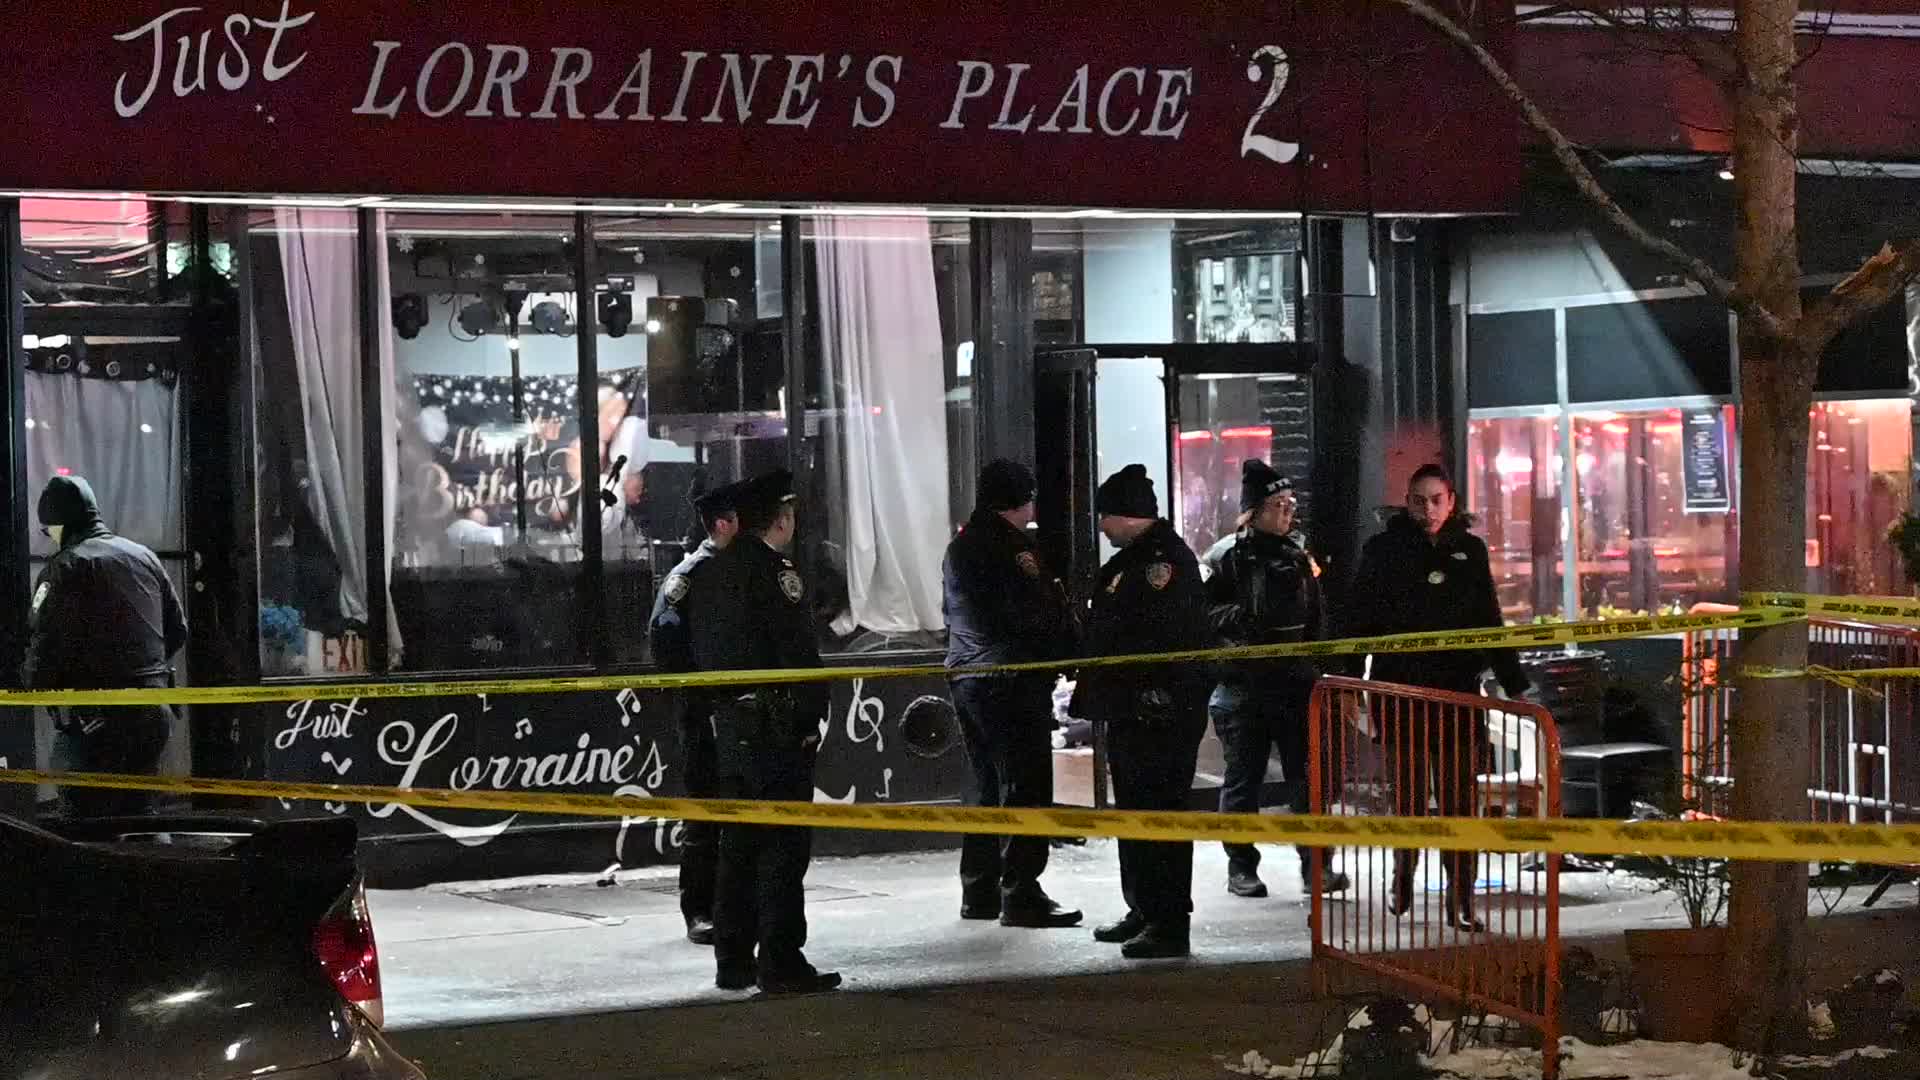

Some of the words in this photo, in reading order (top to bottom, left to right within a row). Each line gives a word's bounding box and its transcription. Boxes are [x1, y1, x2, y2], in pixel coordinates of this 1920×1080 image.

[113, 0, 314, 118] Just
[352, 41, 903, 129] LORRAINE'S
[940, 61, 1192, 139] PLACE
[1241, 45, 1299, 163] 2
[275, 697, 367, 749] Just
[366, 713, 668, 847] Lorraine's
